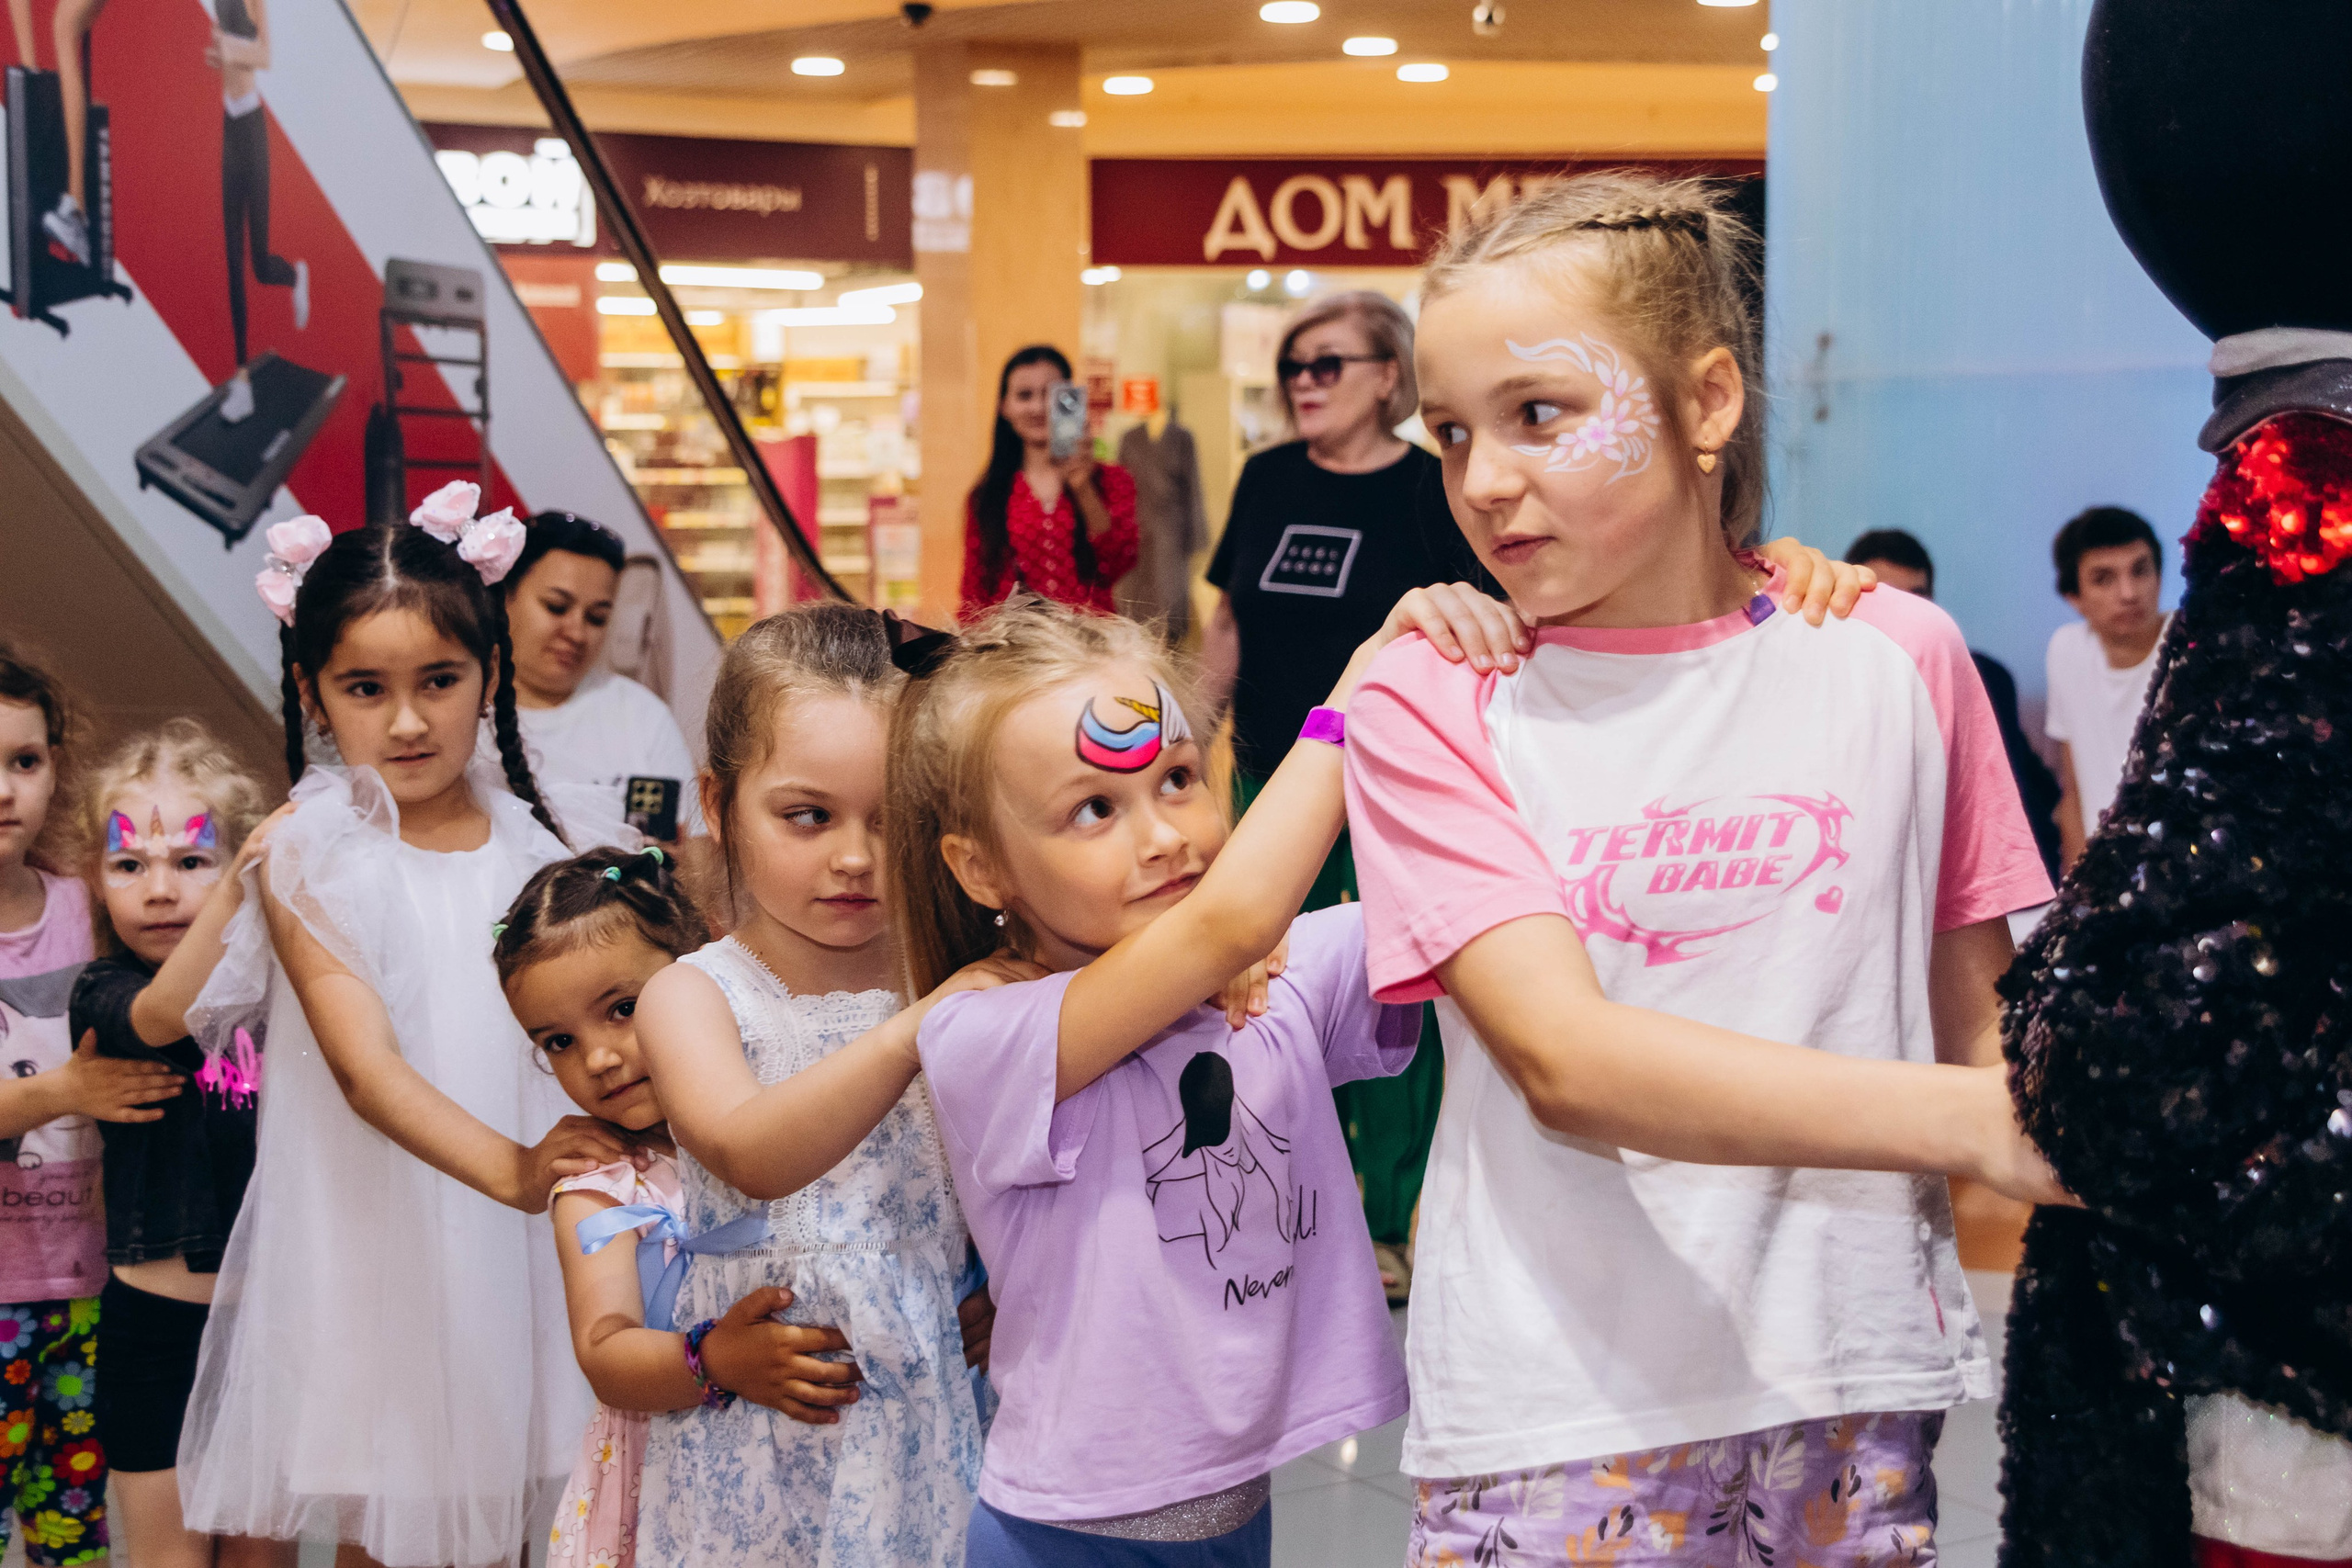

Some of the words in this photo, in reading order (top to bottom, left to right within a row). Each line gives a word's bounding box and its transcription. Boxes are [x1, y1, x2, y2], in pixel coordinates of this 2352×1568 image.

[1204, 175, 1419, 263] ДОМ
[1567, 811, 1806, 865] TERMIT
[1646, 854, 1792, 895] BABE
[1224, 1265, 1294, 1311] Never
